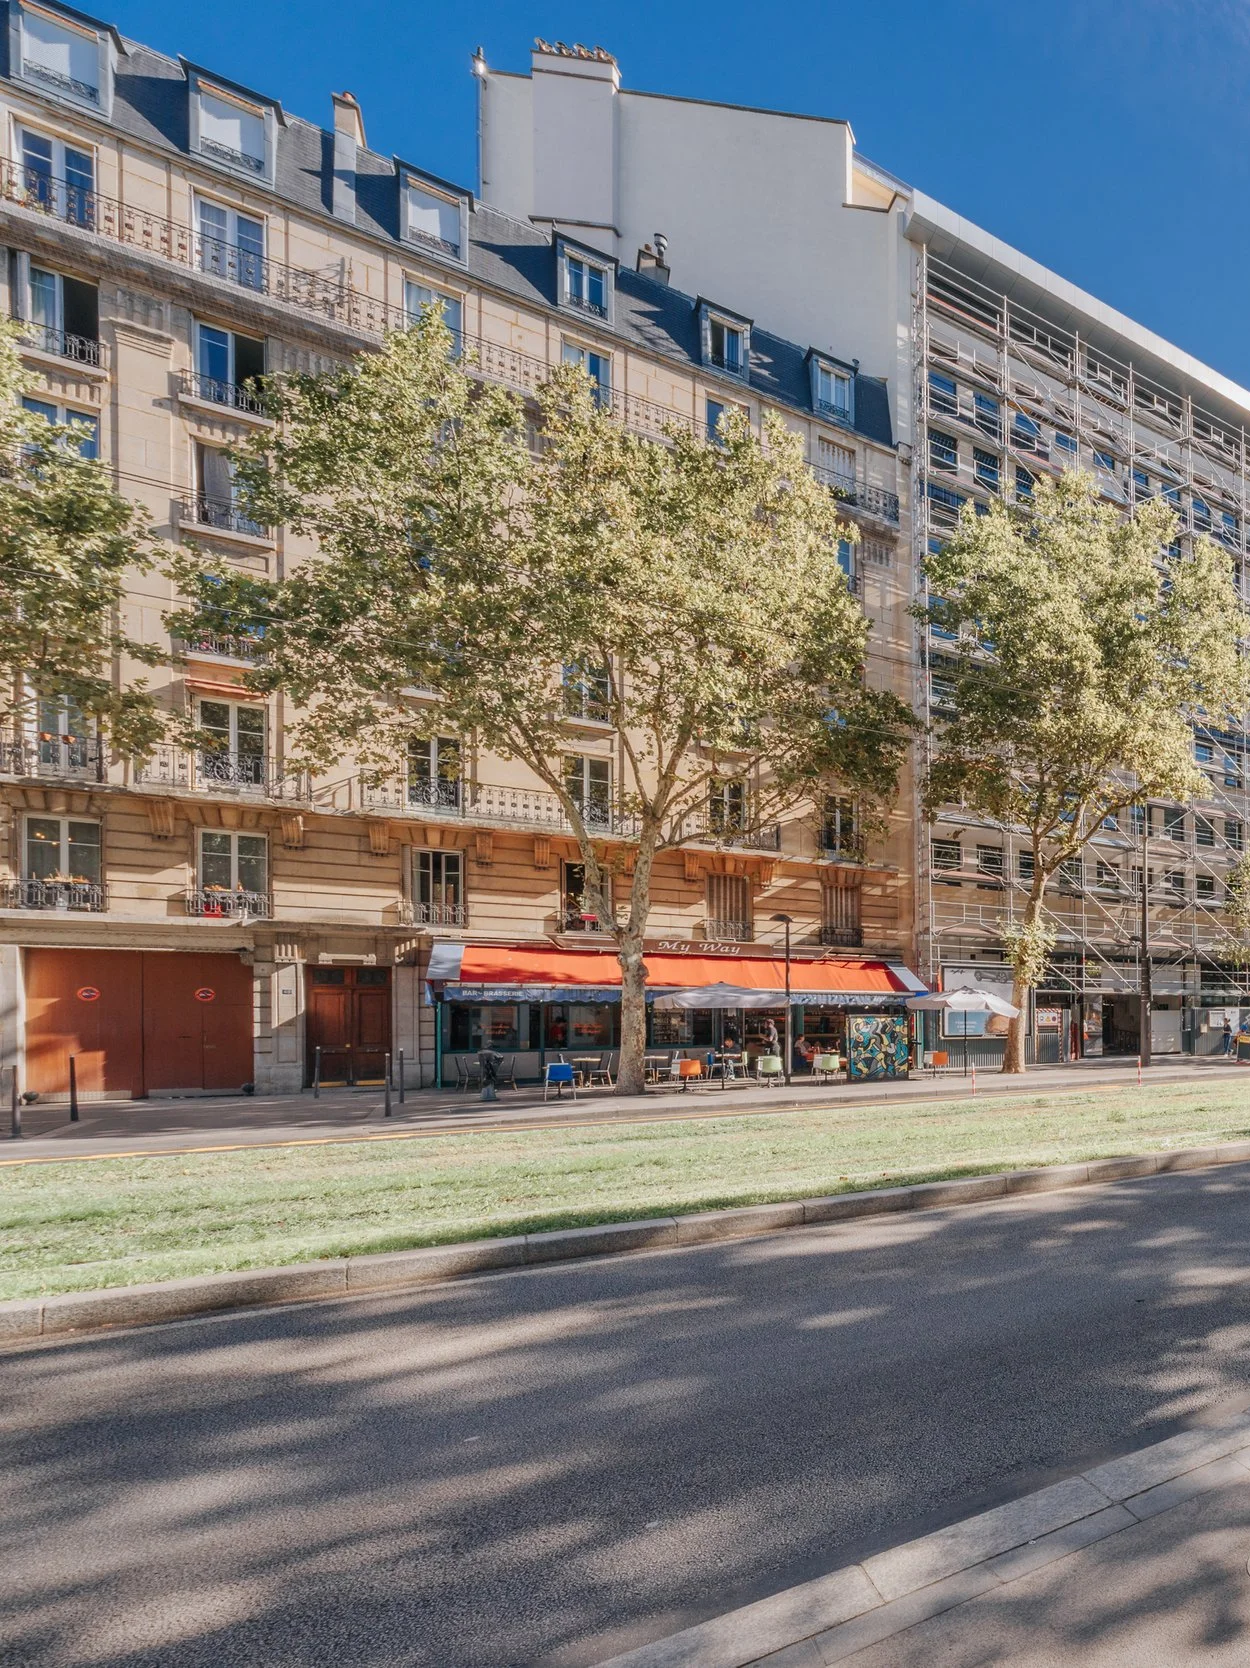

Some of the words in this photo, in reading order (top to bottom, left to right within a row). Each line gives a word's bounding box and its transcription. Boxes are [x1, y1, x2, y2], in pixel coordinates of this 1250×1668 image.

[658, 941, 690, 952] My
[699, 942, 741, 955] Way
[462, 989, 478, 997] BAR
[483, 989, 524, 997] BRASSERIE
